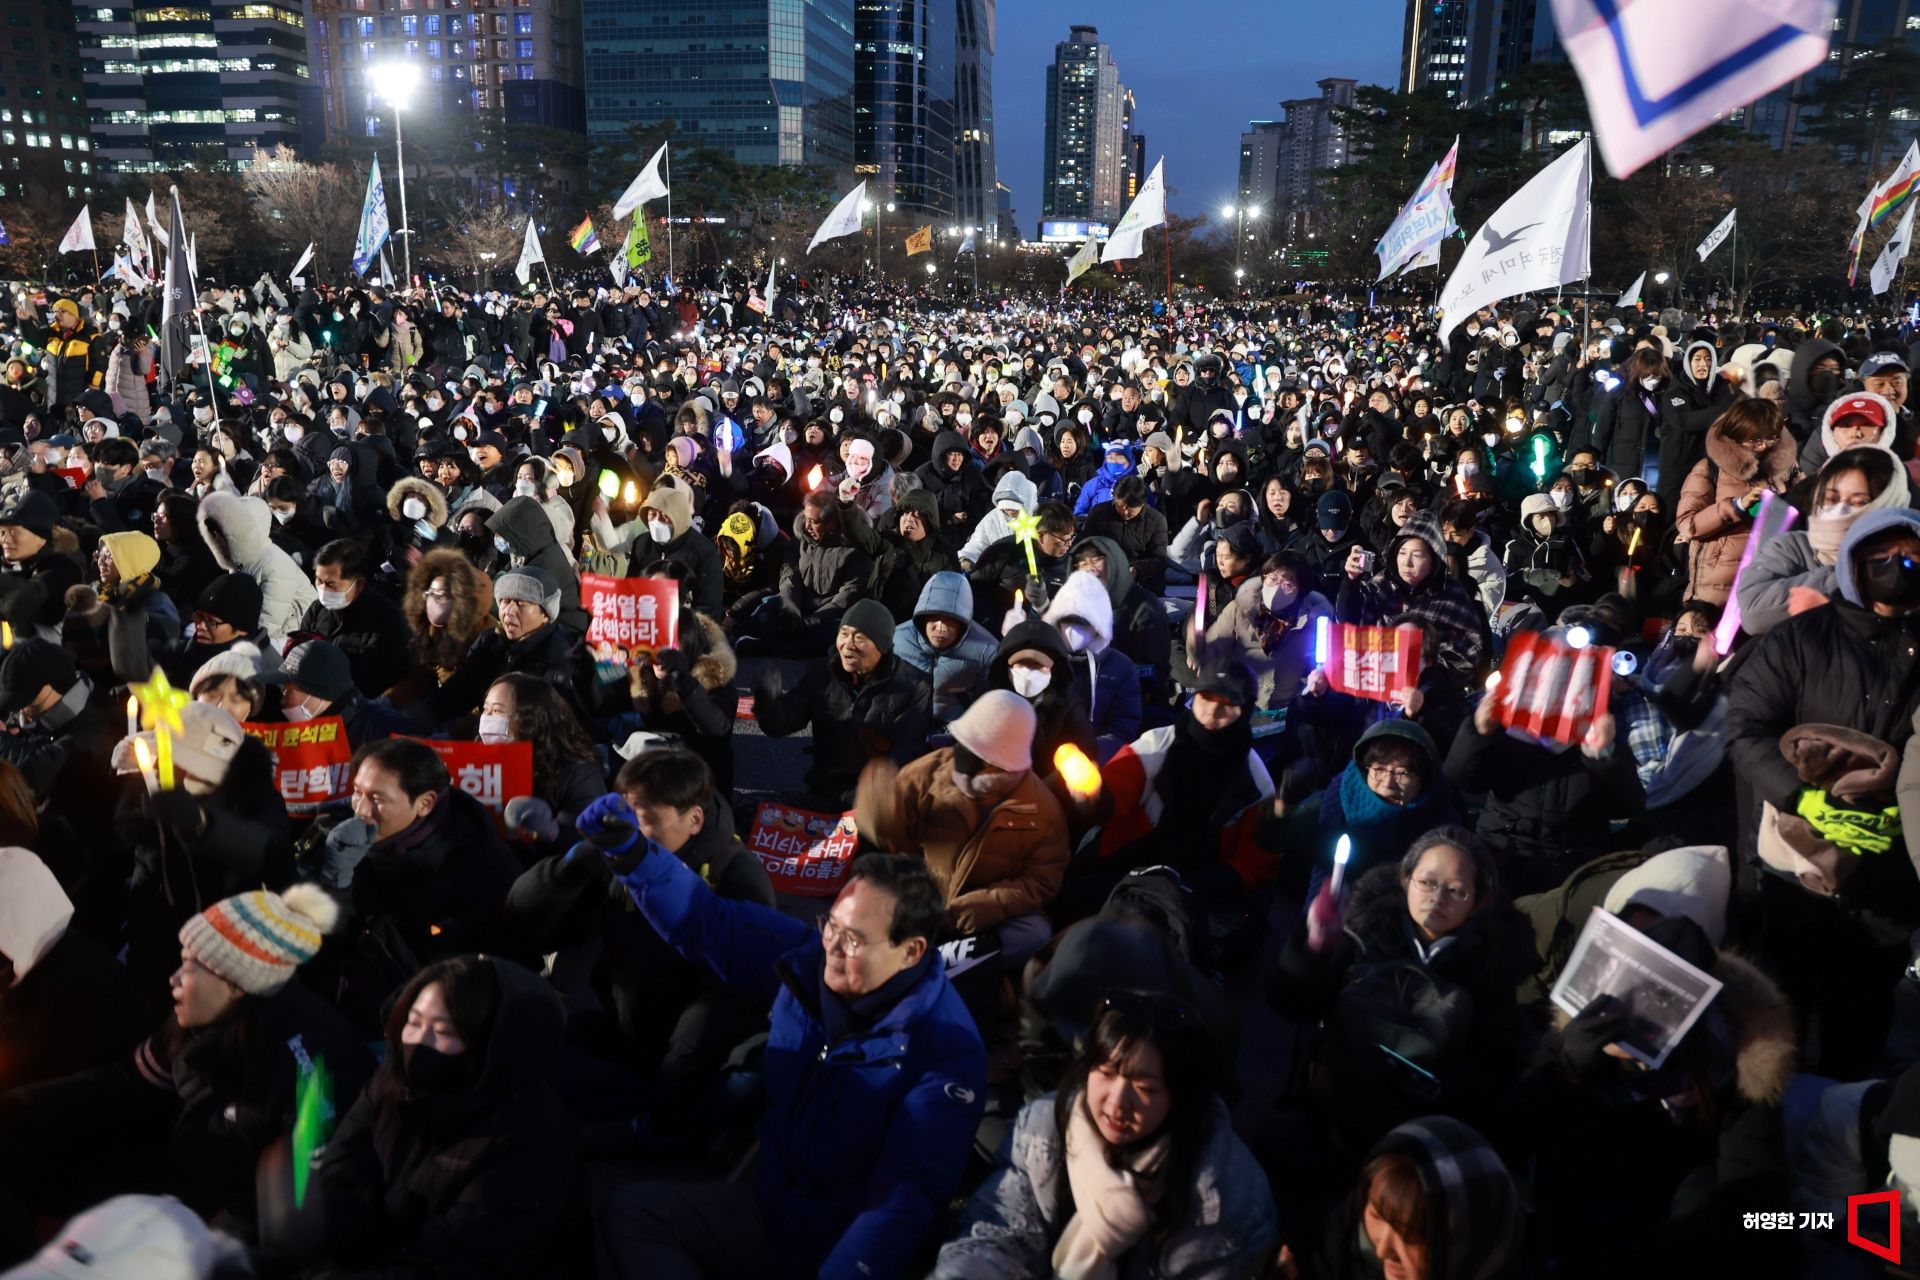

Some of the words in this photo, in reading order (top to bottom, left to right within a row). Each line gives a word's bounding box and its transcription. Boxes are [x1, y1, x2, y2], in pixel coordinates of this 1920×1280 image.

[592, 591, 658, 619] 윤석열을
[591, 616, 659, 646] 탄핵하라
[282, 721, 338, 747] 윤석열
[280, 762, 351, 799] 탄핵!
[450, 763, 502, 814] 핵
[752, 827, 807, 855] 지키자
[808, 839, 855, 859] 나라를
[937, 936, 977, 968] KE
